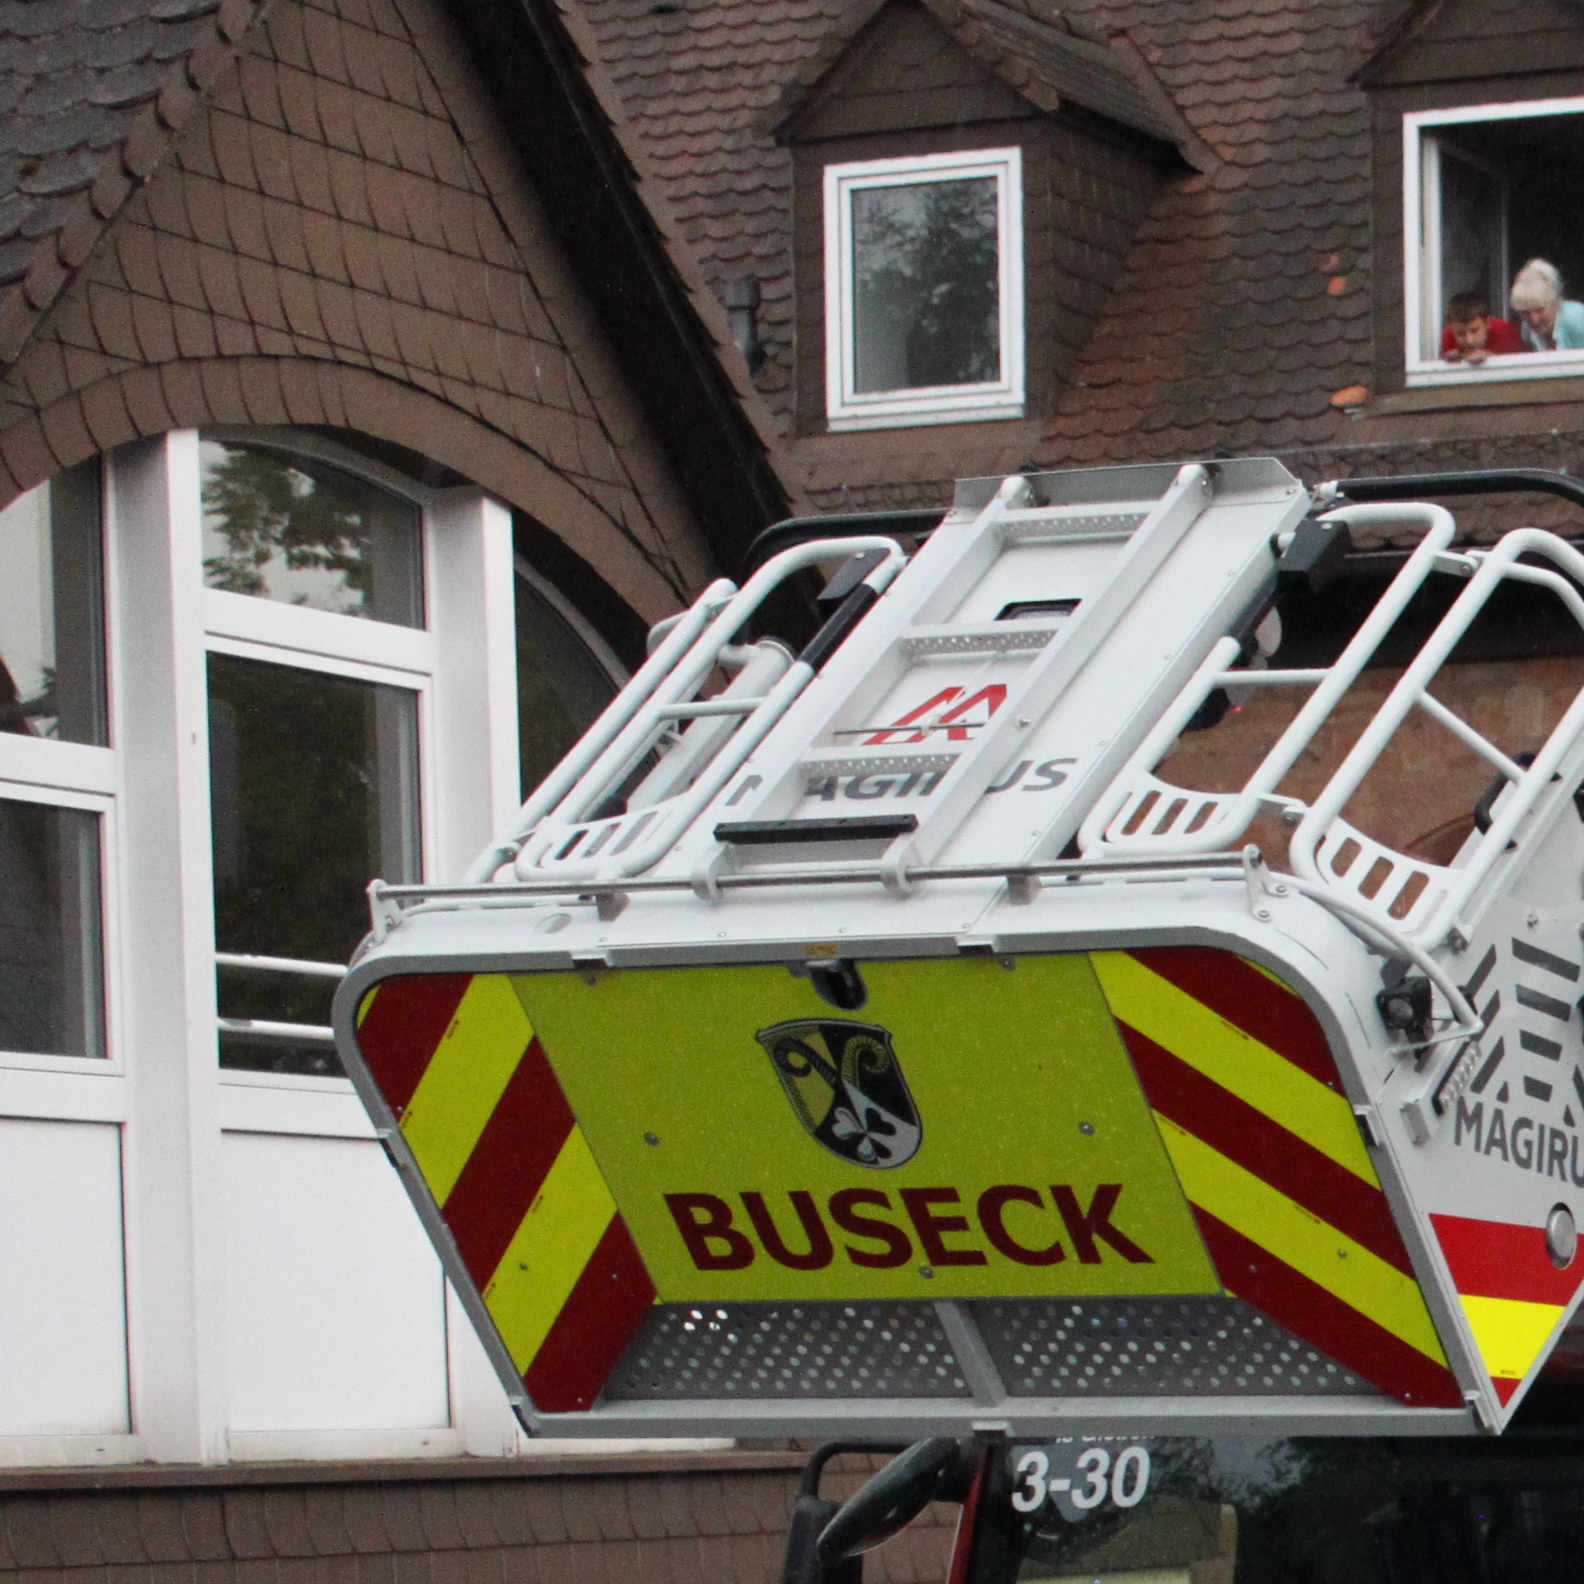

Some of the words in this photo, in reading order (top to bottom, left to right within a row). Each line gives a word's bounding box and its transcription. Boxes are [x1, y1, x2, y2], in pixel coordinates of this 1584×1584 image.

[725, 757, 1078, 806] AGIUS
[662, 1184, 1154, 1271] BUSECK
[1011, 1446, 1150, 1513] 3-30
